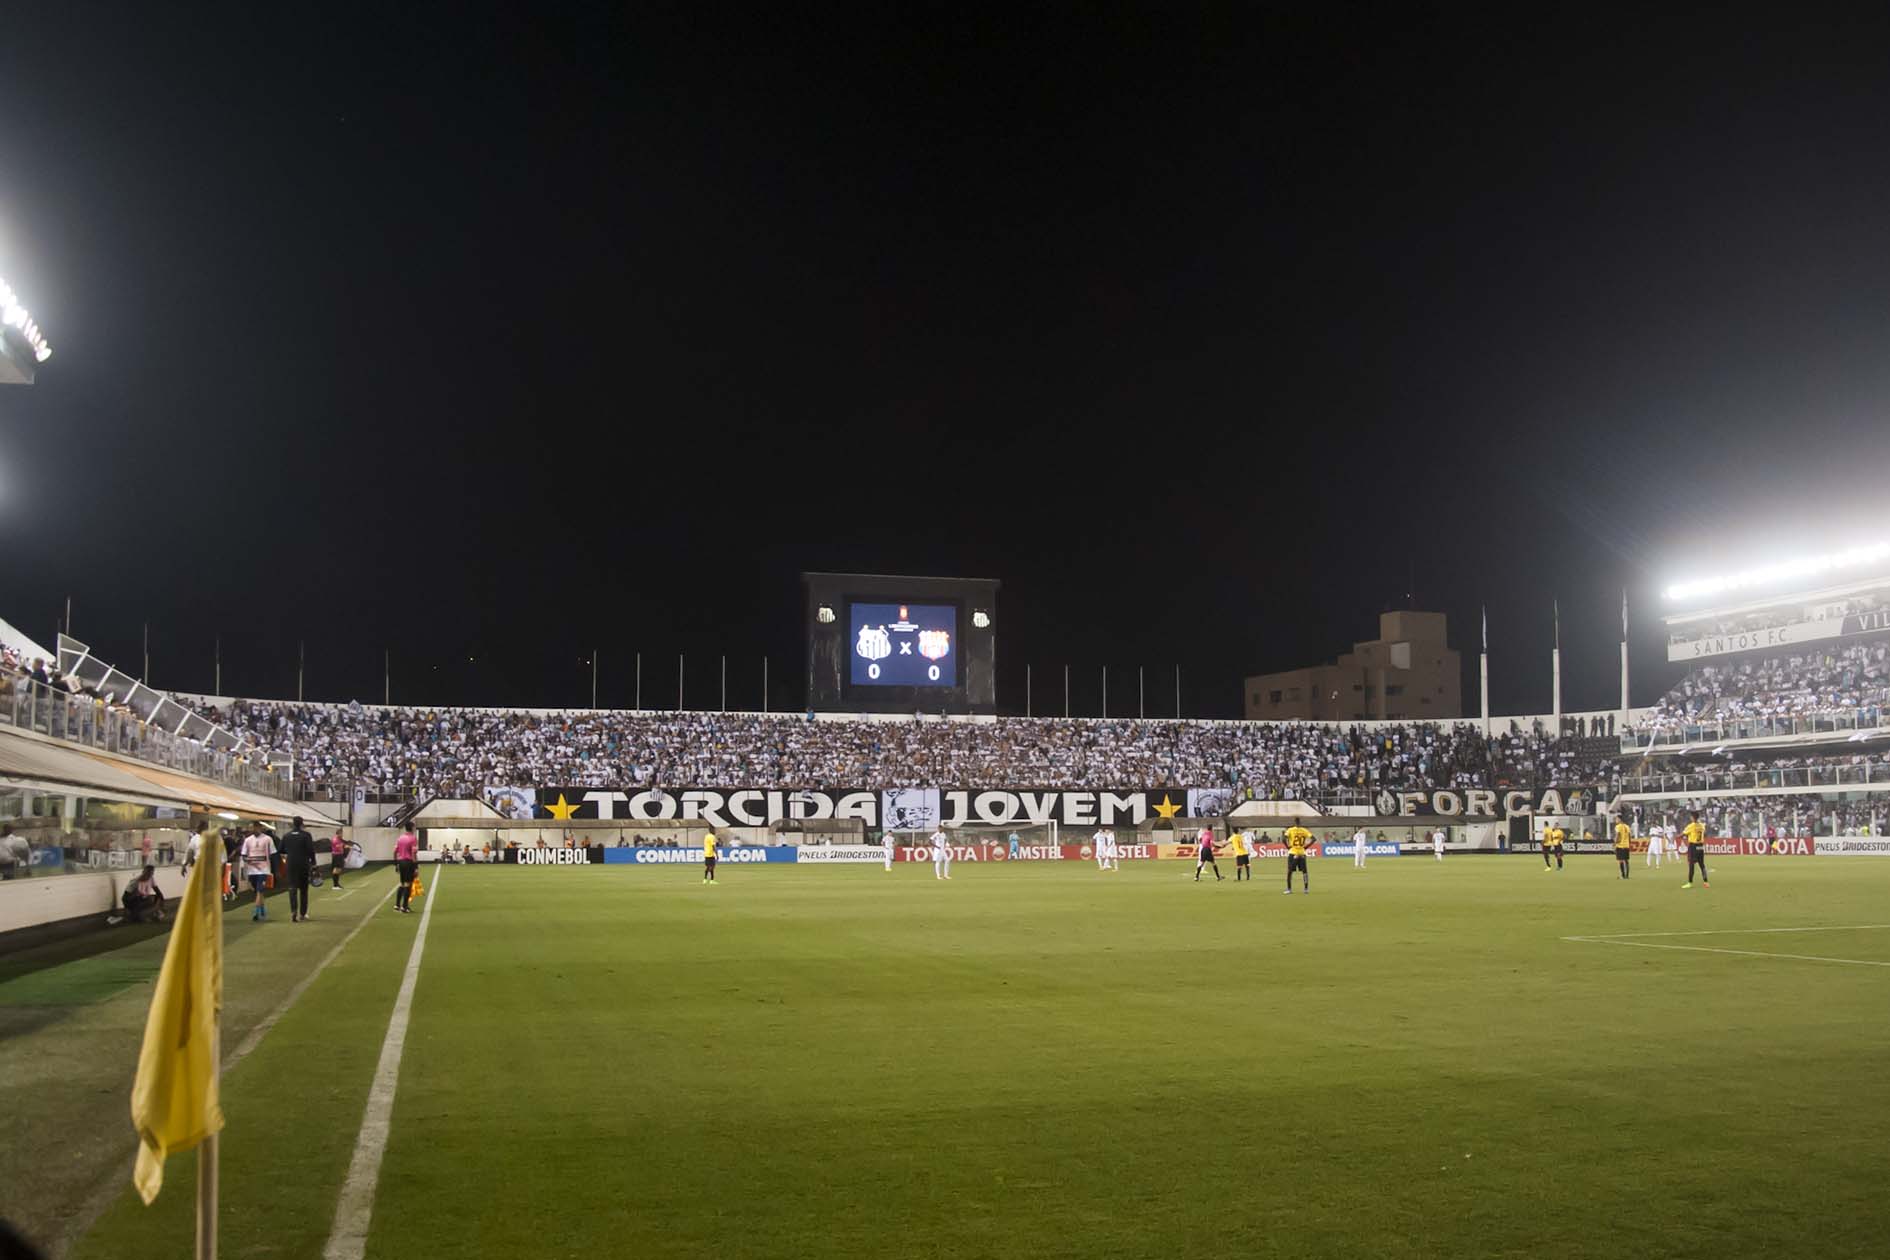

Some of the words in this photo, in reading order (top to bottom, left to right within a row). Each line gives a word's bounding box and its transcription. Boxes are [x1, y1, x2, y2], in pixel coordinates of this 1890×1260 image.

[1694, 633, 1758, 655] SANTOS
[868, 664, 881, 680] 0
[928, 665, 940, 681] 0
[582, 791, 877, 827] TORCIDA
[942, 791, 1147, 828] JOVEM
[1293, 836, 1306, 846] 20
[1746, 838, 1809, 854] TOOTA
[1816, 842, 1840, 851] PNEUS
[517, 848, 591, 864] CONMEBOL
[636, 849, 767, 862] CONMEBL.COM
[799, 851, 827, 859] PNEUS
[829, 850, 886, 859] BRIDGESTON
[1096, 846, 1150, 858] STEL
[1259, 846, 1317, 857] Santer
[1325, 845, 1397, 855] CONMOL.COM
